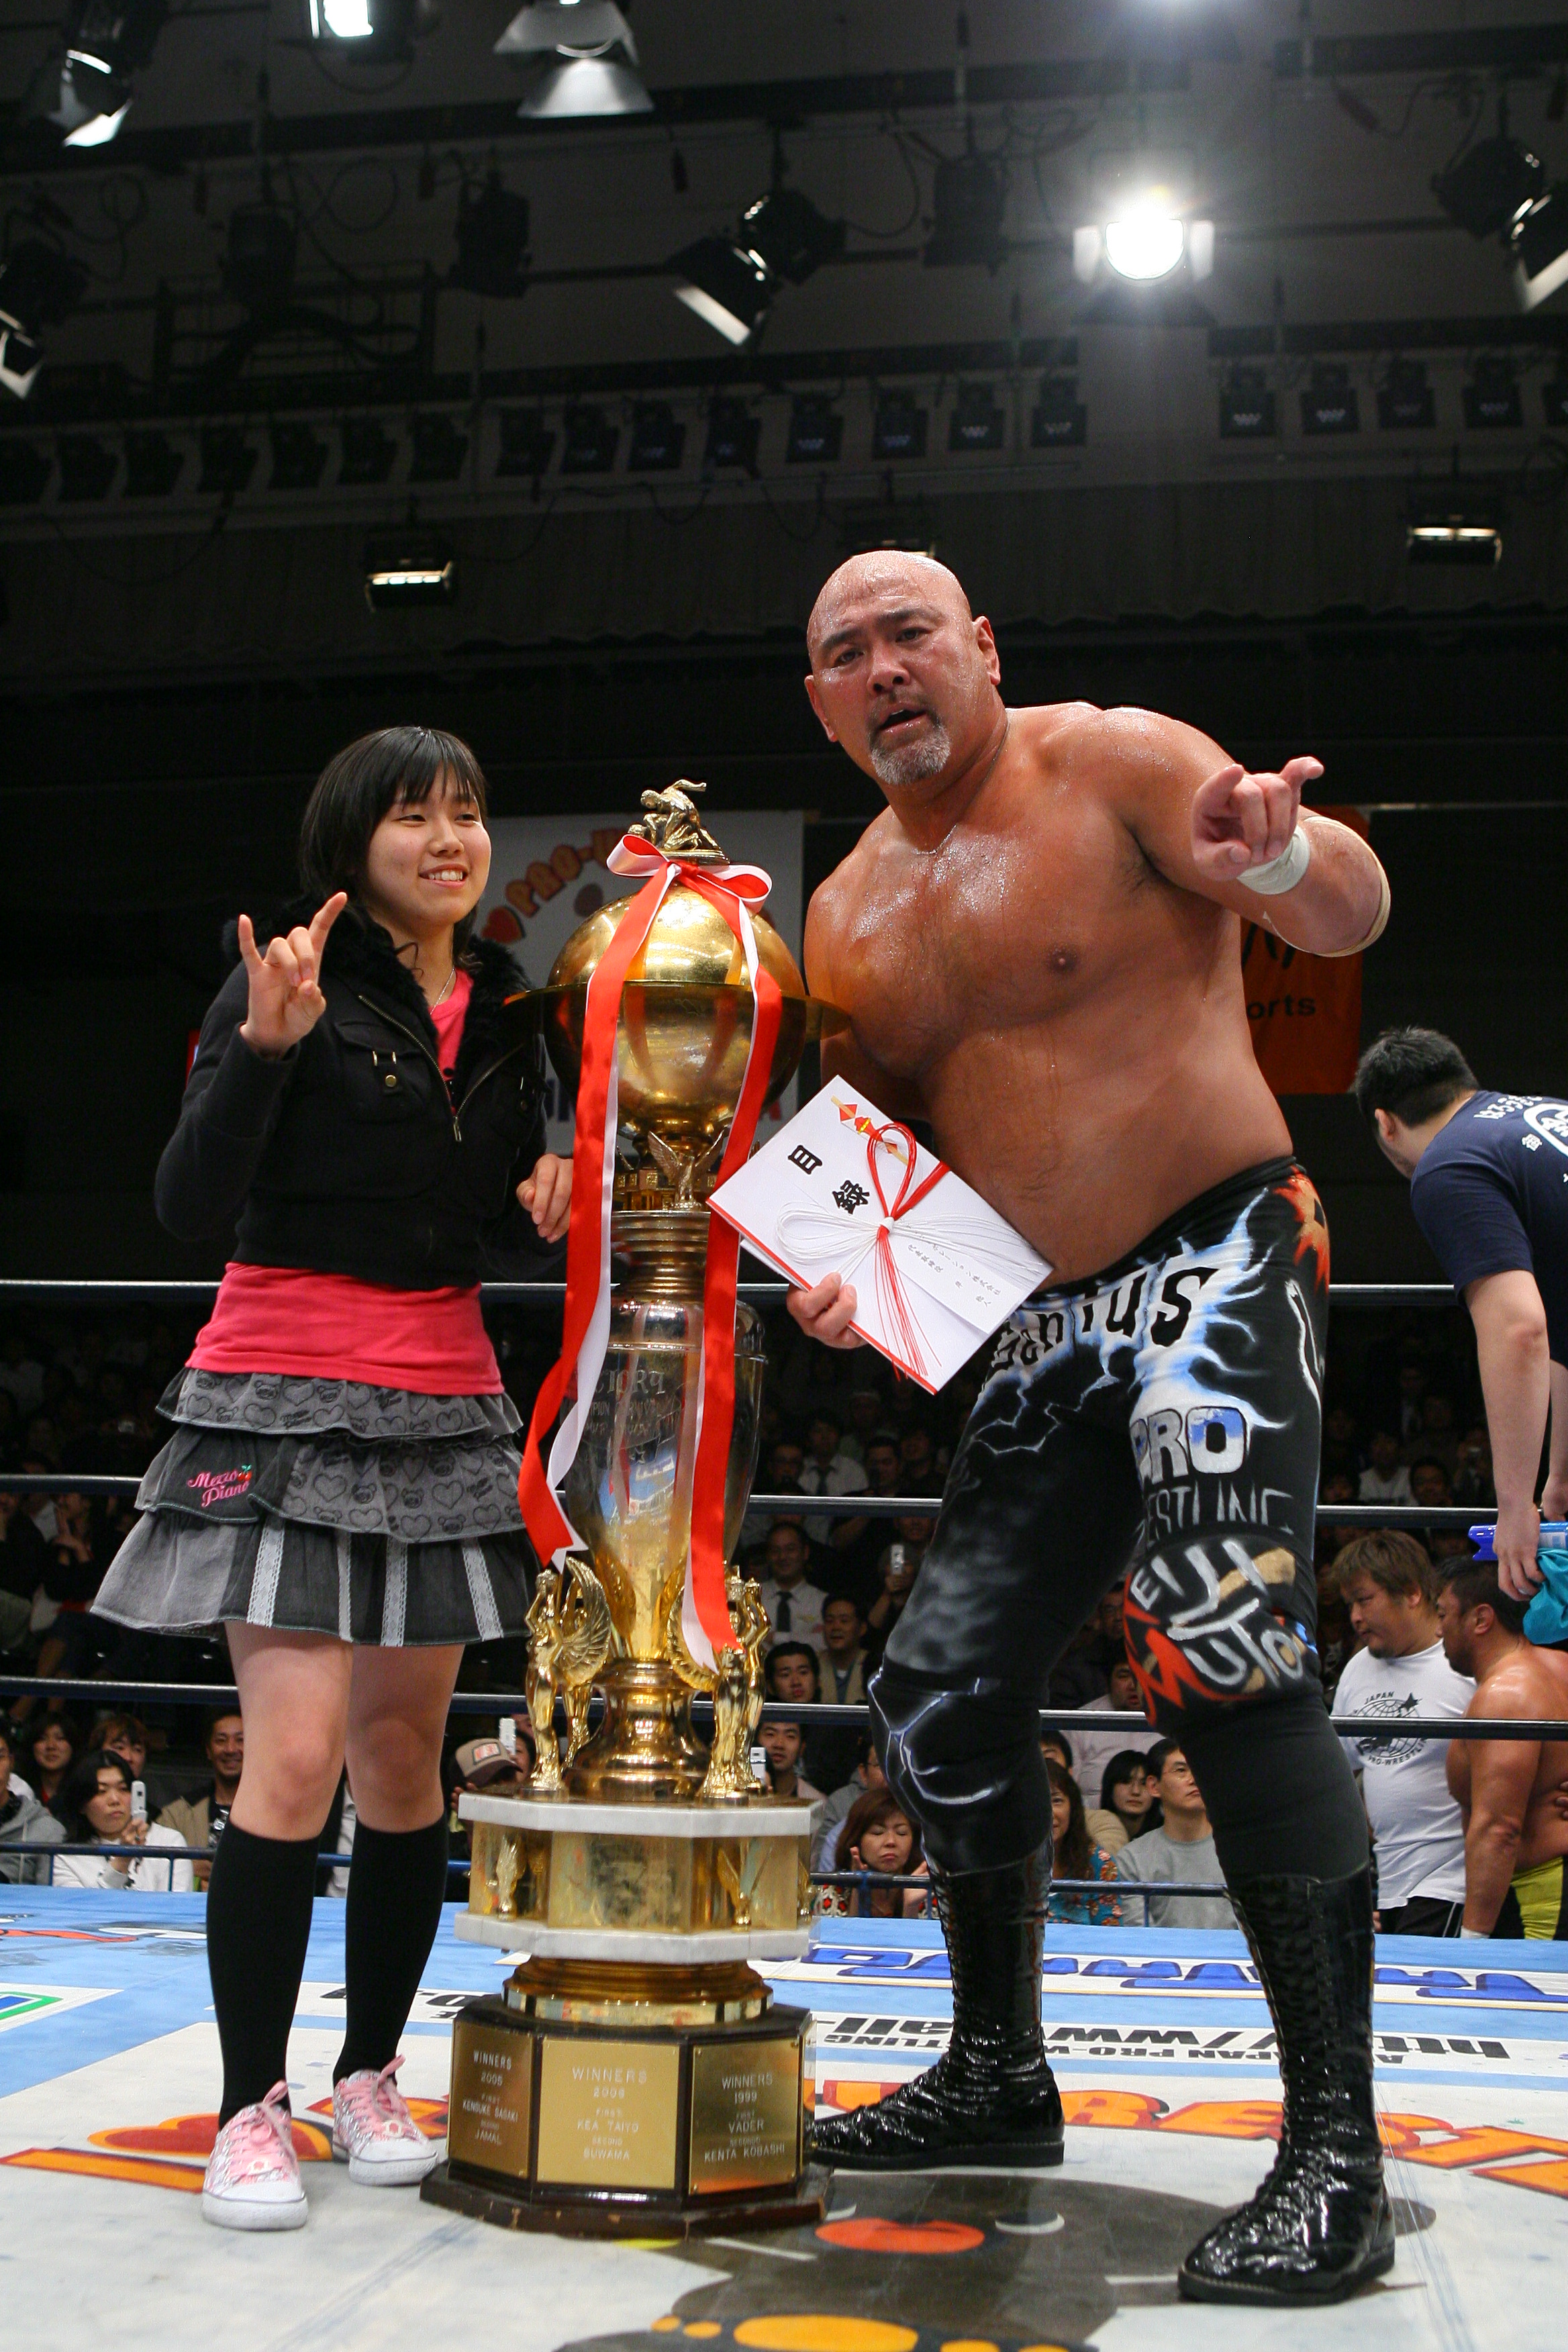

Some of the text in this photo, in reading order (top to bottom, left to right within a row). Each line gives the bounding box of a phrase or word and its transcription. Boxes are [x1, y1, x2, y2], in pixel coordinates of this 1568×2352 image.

[788, 1145, 870, 1214] 目録
[187, 1469, 238, 1488] Mezzo
[201, 1481, 250, 1508] Piano
[1365, 1692, 1395, 1704] JAPAN
[473, 2050, 511, 2070] WINNERS
[572, 2066, 647, 2084] WINNERS
[722, 2072, 773, 2090] WINNERS
[734, 2091, 758, 2105] 1999
[577, 2119, 639, 2133] KEA TAIYO
[728, 2118, 765, 2134] VADER
[475, 2129, 501, 2145] JAMAL
[705, 2148, 737, 2163] KENTA
